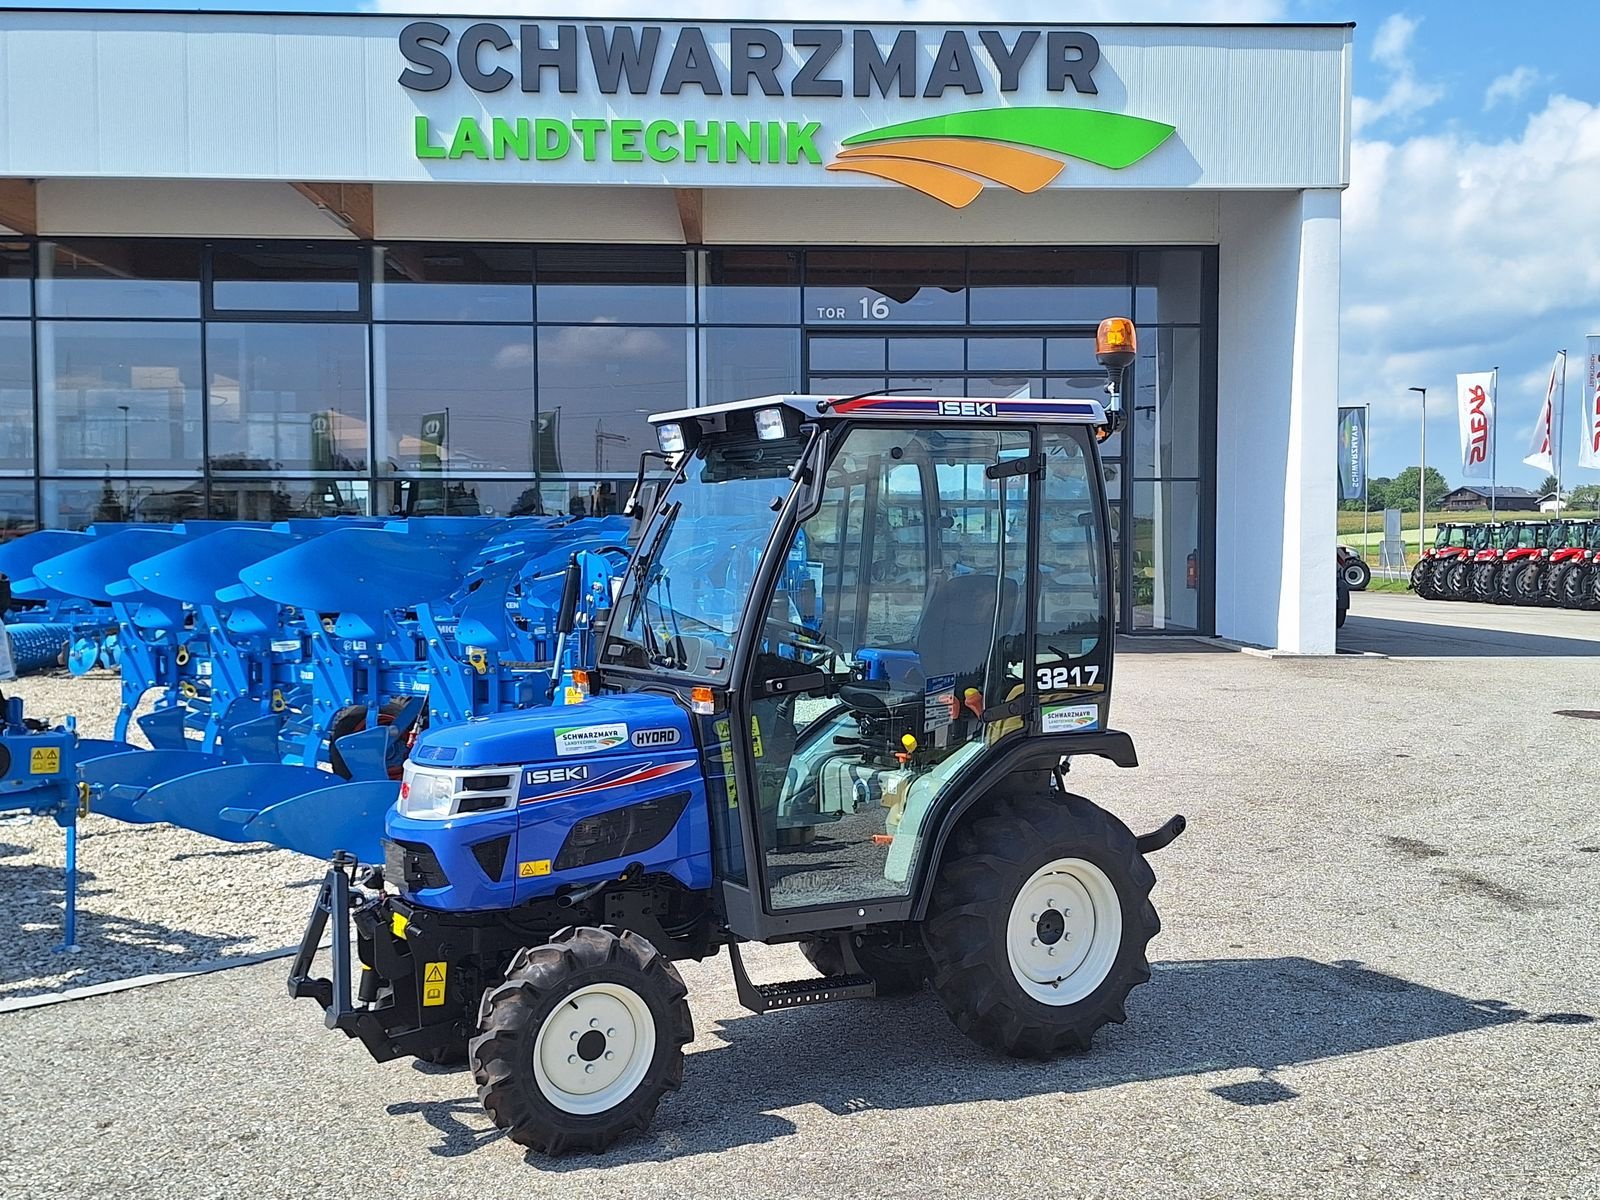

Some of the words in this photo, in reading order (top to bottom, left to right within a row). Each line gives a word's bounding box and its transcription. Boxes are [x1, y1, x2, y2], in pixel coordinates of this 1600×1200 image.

[398, 21, 1101, 98] SCHWARZMAYR
[414, 116, 823, 166] LANDTECHNIK
[816, 307, 846, 319] TOR
[859, 297, 889, 319] 16
[938, 401, 998, 416] ISEKI
[1036, 665, 1099, 690] 3217
[1047, 711, 1091, 719] SCHWARZMAYR
[562, 730, 618, 741] SCHWARZMAYR
[636, 730, 675, 745] HYDRO
[526, 766, 588, 785] ISEKI
